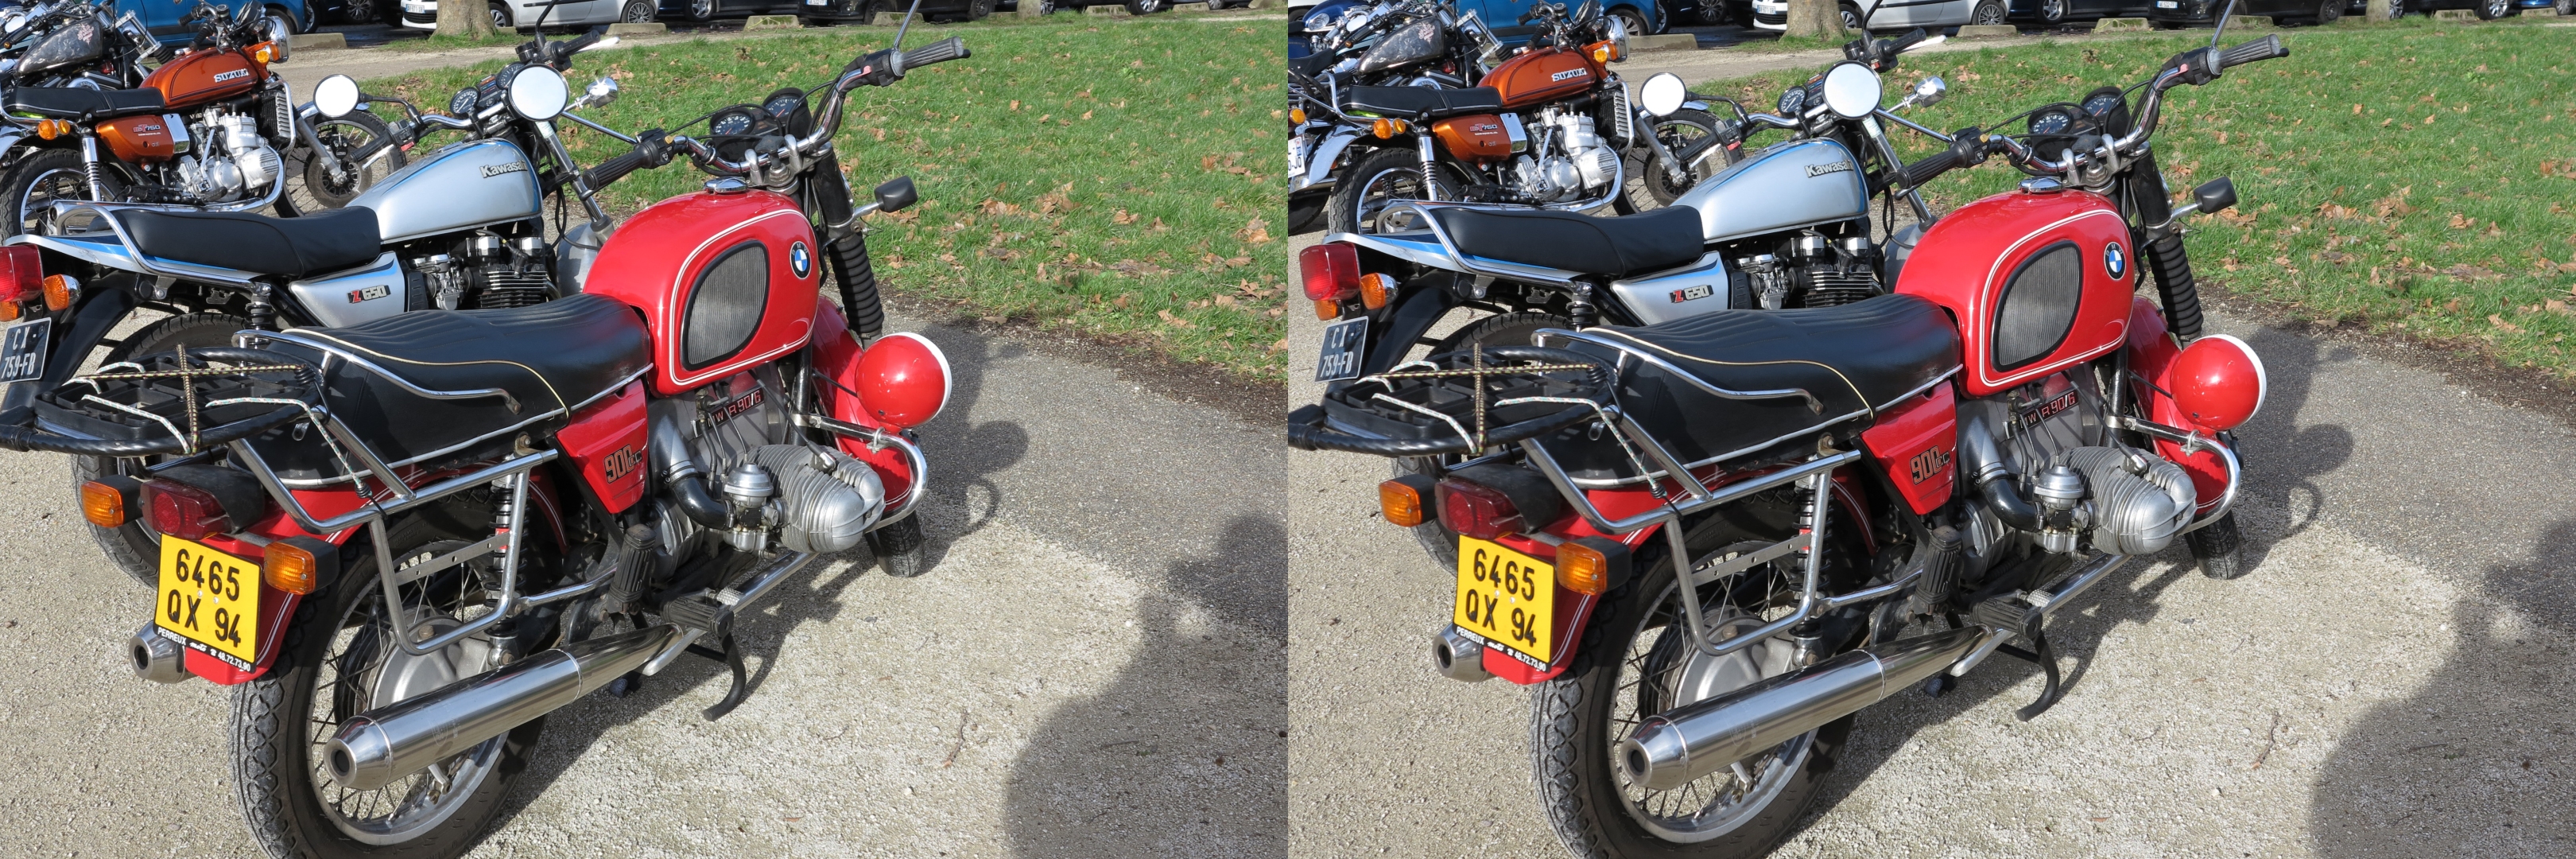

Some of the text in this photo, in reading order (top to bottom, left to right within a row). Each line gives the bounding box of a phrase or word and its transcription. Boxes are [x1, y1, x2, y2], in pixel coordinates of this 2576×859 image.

[213, 68, 250, 83] SUZUKI
[1551, 67, 1588, 82] SUZUKI
[791, 243, 809, 256] BMW
[2105, 243, 2123, 256] BMW
[1, 352, 36, 379] 759-FB
[1320, 351, 1354, 378] 759-FB
[176, 548, 240, 601] 6465
[1473, 548, 1535, 601] 6465
[167, 589, 241, 647] QX 94
[1465, 589, 1537, 647] QX 94
[157, 627, 187, 646] PERREUX
[217, 651, 250, 672] 48.72.73.90
[1456, 626, 1484, 645] PERREUX
[1515, 651, 1546, 672] 48.72.73.90
